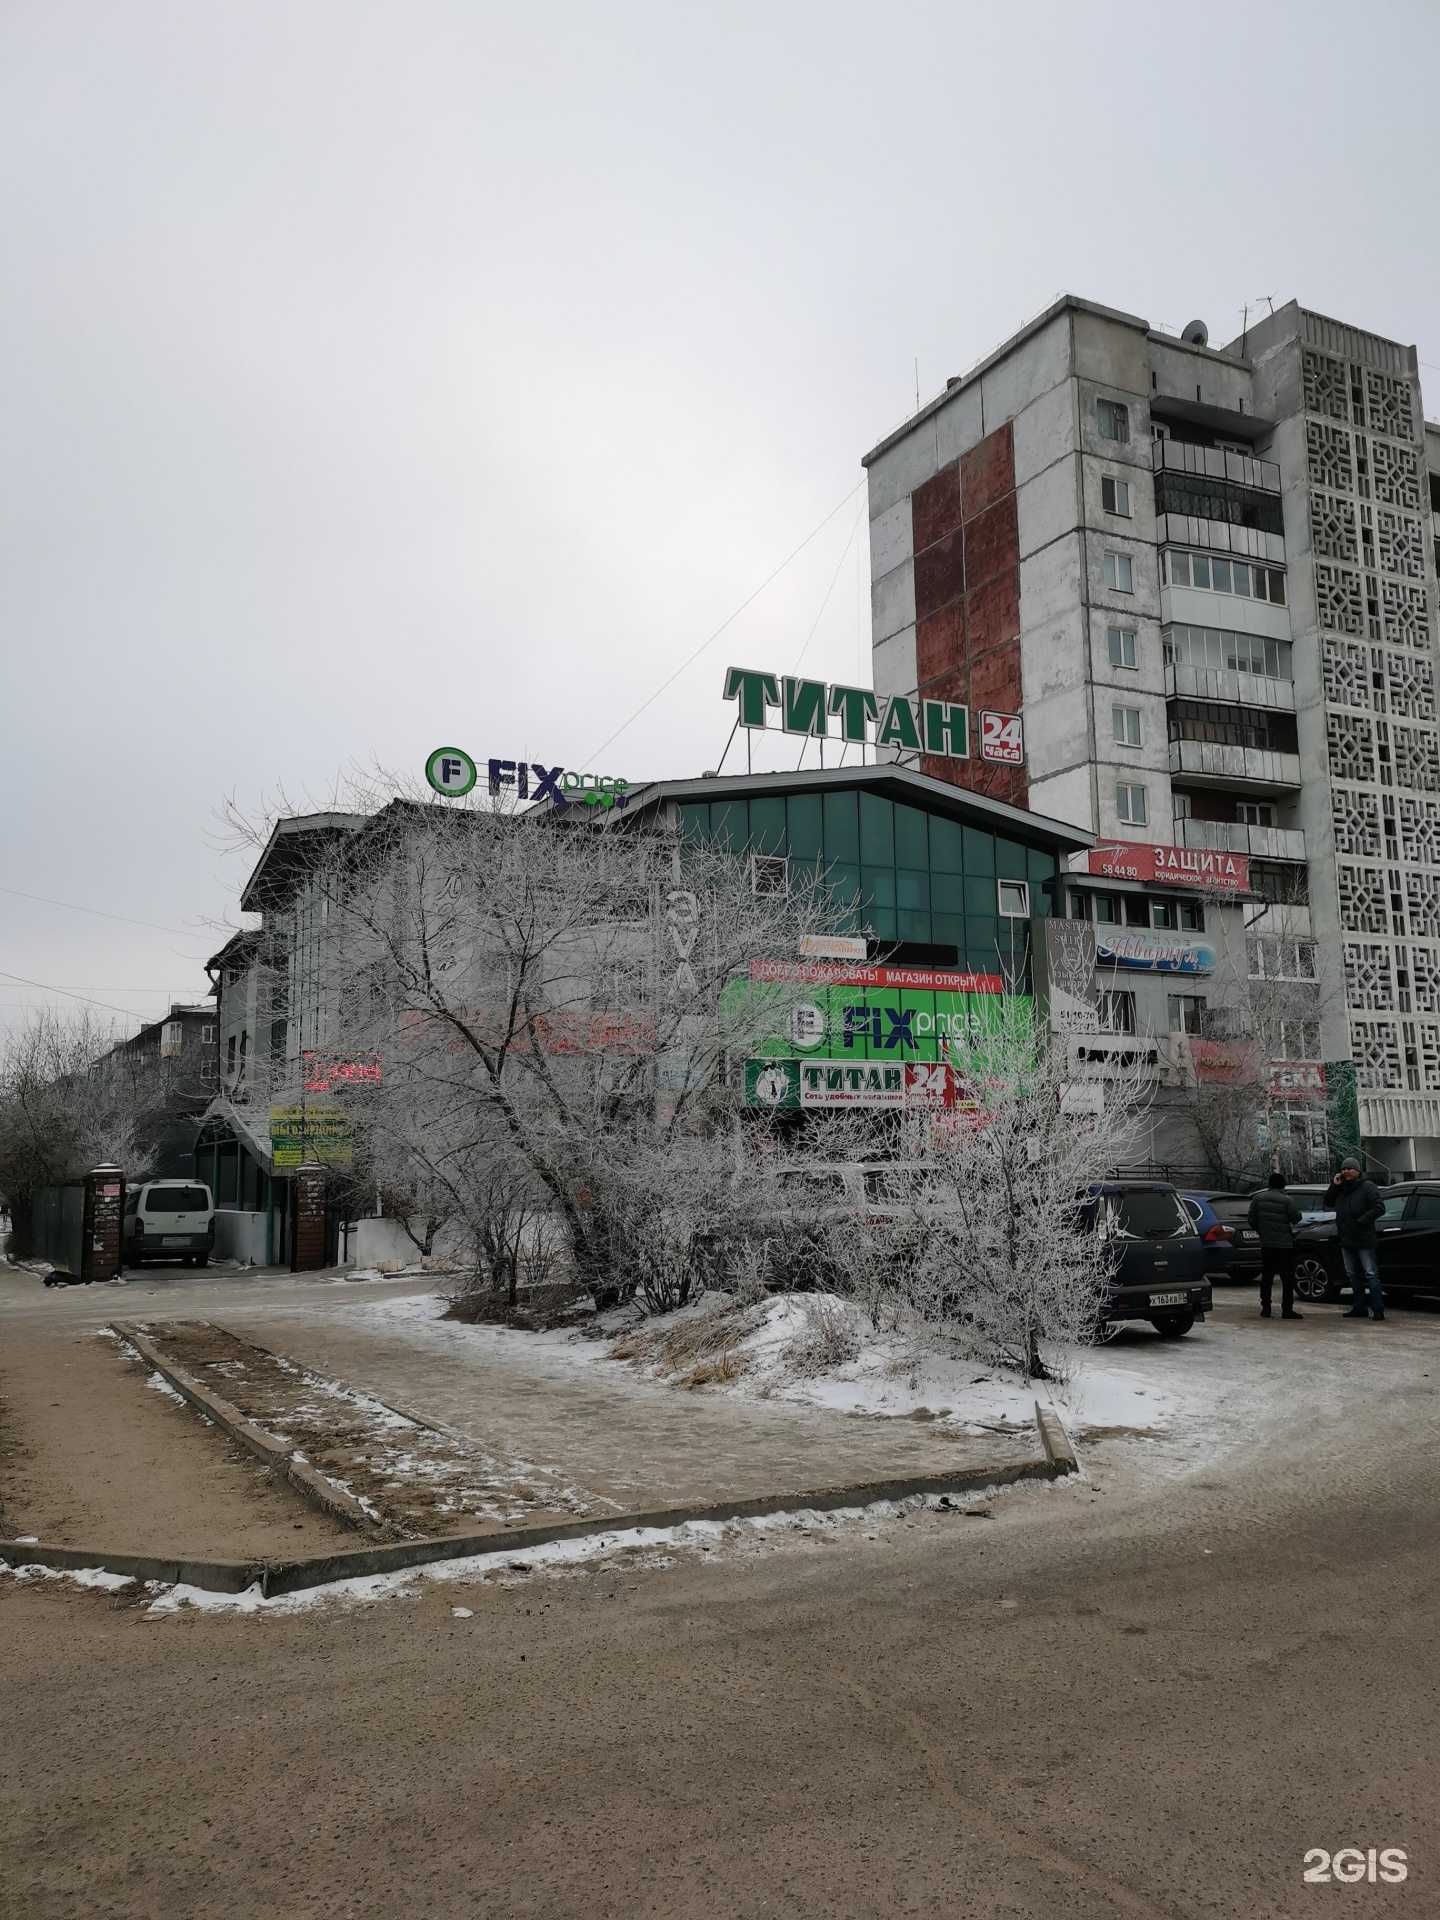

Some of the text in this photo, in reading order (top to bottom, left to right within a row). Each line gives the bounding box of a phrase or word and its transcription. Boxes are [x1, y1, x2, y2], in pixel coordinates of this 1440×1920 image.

[722, 666, 970, 760] ТИТАН
[984, 714, 1021, 747] 24
[985, 745, 1020, 759] часа
[442, 758, 461, 783] F
[488, 758, 629, 814] FIX price
[1154, 847, 1237, 876] ЗАЩИТА
[885, 971, 932, 985] МАГАЗИН
[934, 973, 975, 987] ОТКРЫТ
[842, 1006, 920, 1049] FIX
[802, 1065, 947, 1096] ТИТАН 24
[804, 1092, 824, 1100] Сеть
